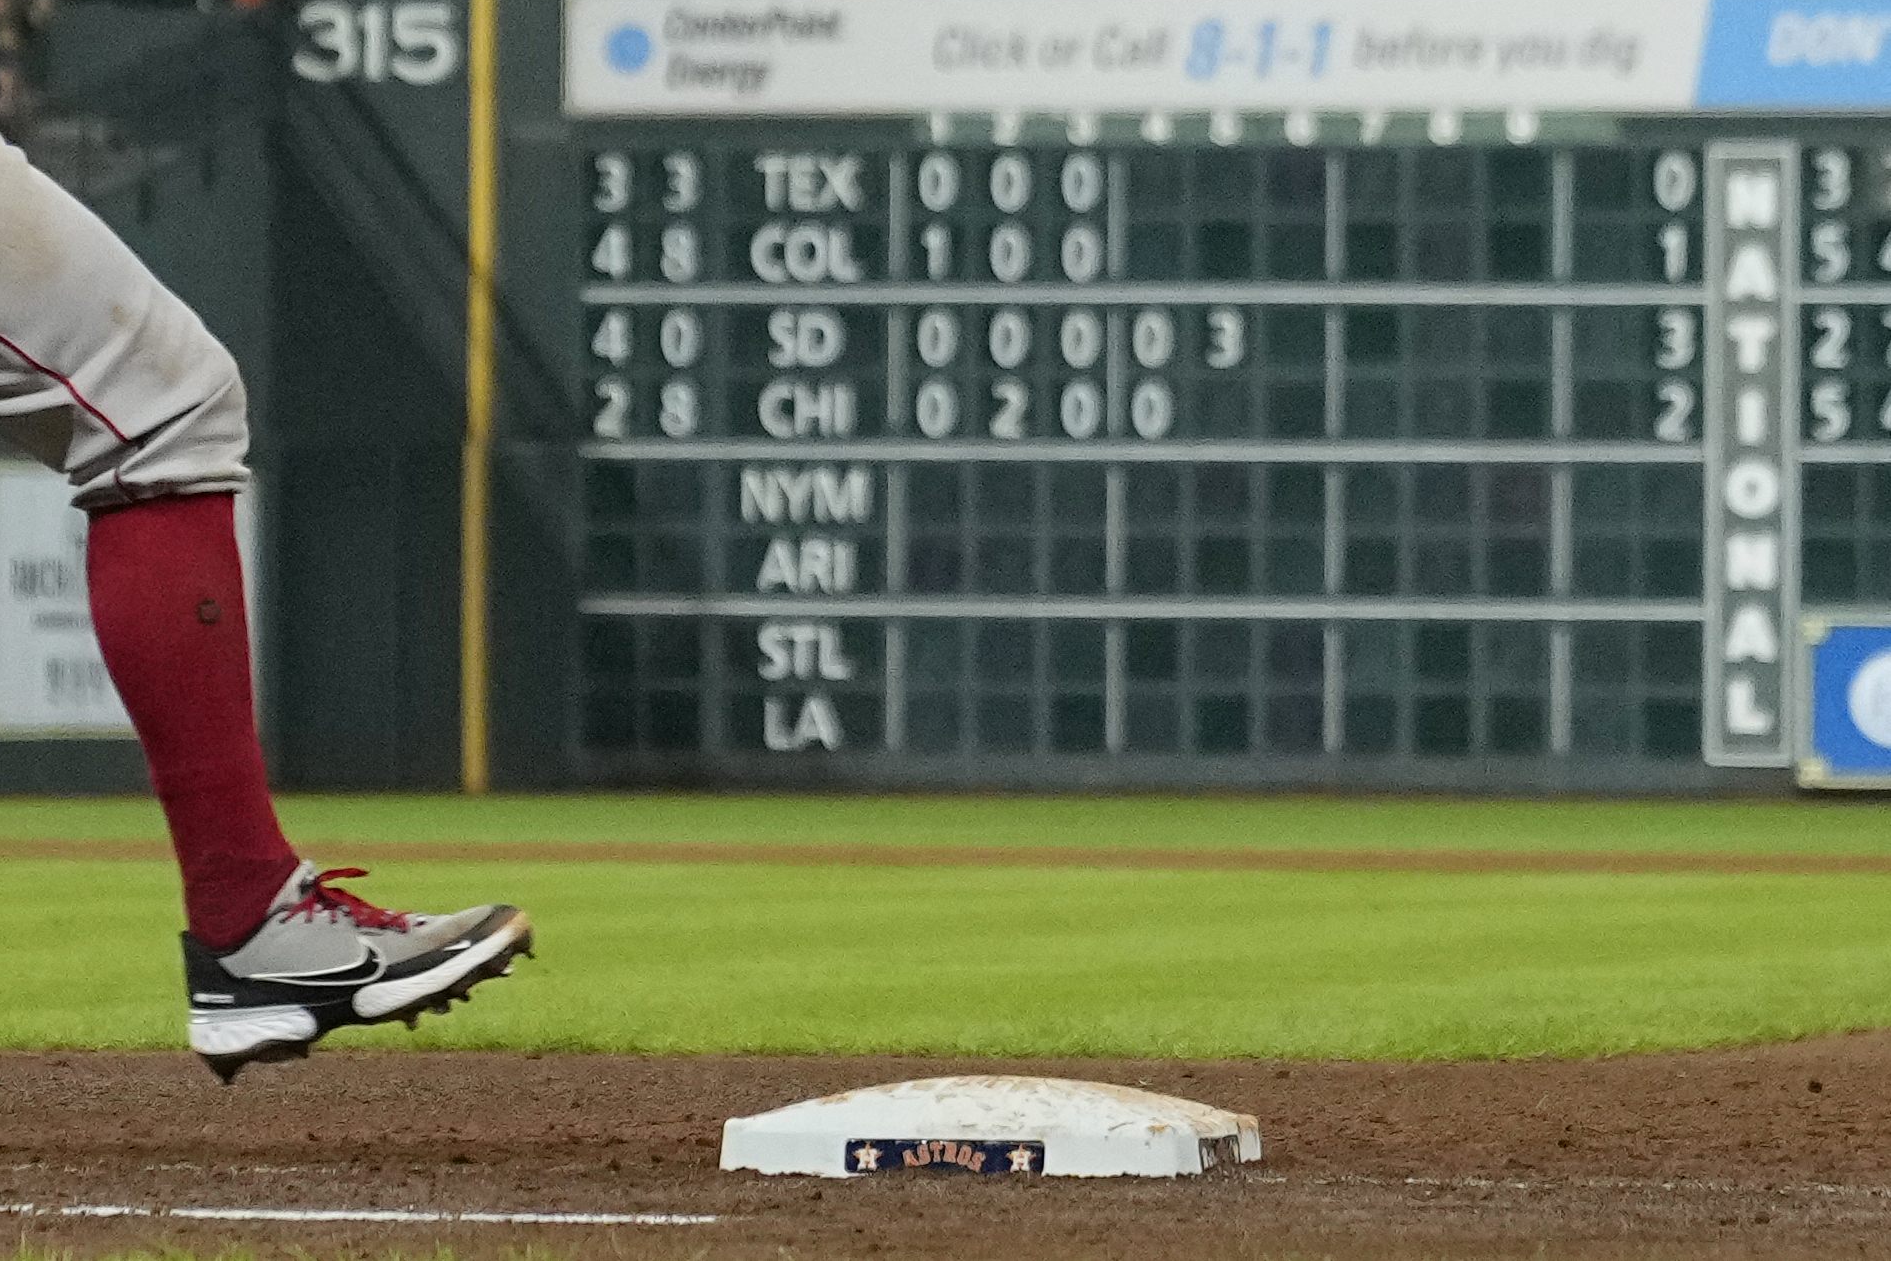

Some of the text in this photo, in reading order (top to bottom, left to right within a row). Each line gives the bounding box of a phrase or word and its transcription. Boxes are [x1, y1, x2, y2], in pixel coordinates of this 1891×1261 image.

[755, 152, 860, 212] TEX
[749, 222, 862, 282] COL
[767, 307, 845, 369] SD
[757, 378, 856, 440] CHI
[1723, 166, 1781, 737] NATIONAL
[746, 466, 870, 522] NYM
[757, 536, 855, 594] ARI
[757, 617, 852, 681] STL
[763, 694, 841, 752] LA
[902, 1141, 986, 1172] ASTROS
